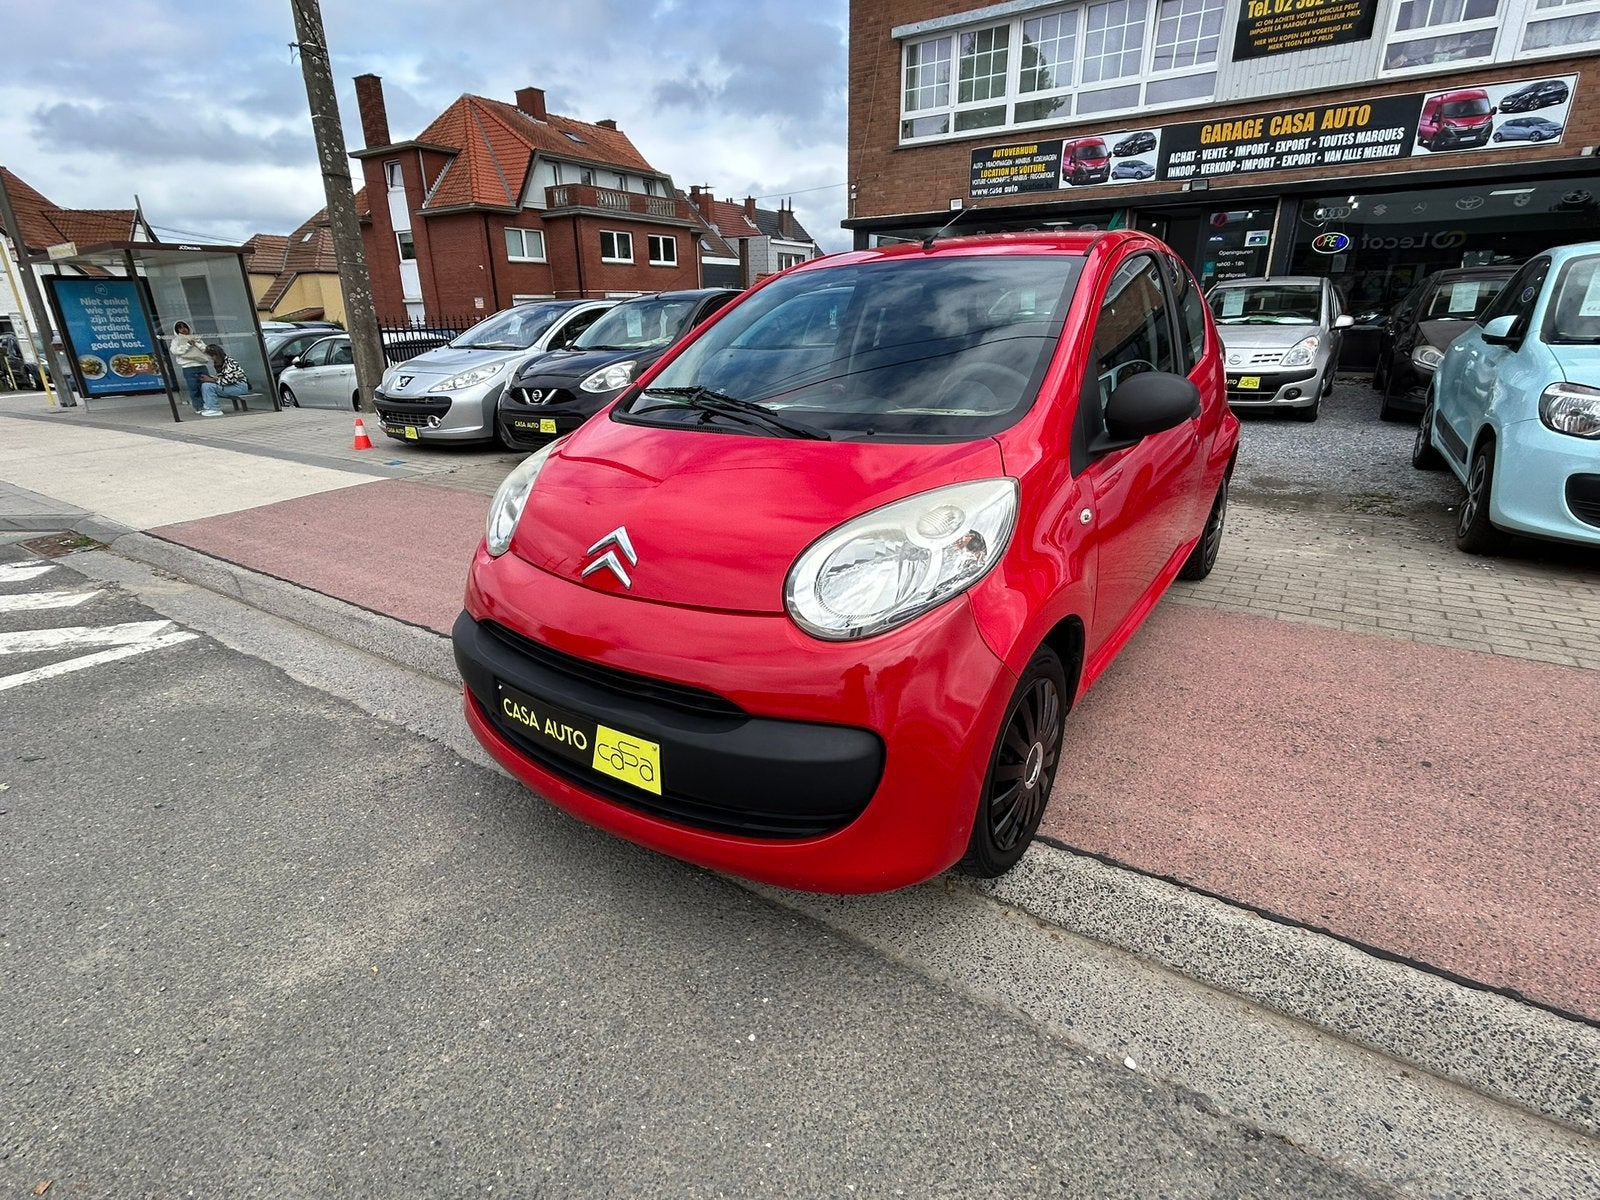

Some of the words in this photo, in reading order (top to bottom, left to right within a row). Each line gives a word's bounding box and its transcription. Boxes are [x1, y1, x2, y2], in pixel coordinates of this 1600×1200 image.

[1248, 1, 1271, 18] Tel.
[1274, 14, 1295, 23] ACHETE
[1297, 10, 1315, 19] VOTRE
[1316, 5, 1343, 15] VEHICULE
[1344, 2, 1360, 10] PEUT
[1282, 20, 1307, 30] MARQUE
[1318, 12, 1346, 22] MEILLEUR
[1346, 10, 1361, 18] PRIX
[1254, 38, 1266, 46] HIER
[1279, 33, 1299, 42] KOPEN
[1268, 42, 1284, 50] MERK
[1284, 39, 1302, 48] TEGEN
[1201, 118, 1263, 144] GARAGE
[1269, 110, 1315, 135] CASA
[1321, 104, 1372, 130] AUTO
[992, 145, 1038, 158] AUTOVERHUUR
[1170, 151, 1197, 164] ACHAT
[1202, 147, 1228, 160] VENTE
[1234, 143, 1270, 158] IMPORT
[1276, 138, 1311, 153] EXPORT
[1319, 132, 1354, 148] TOUTES
[1355, 126, 1405, 144] MARQUES
[1168, 164, 1196, 178] INKOOP
[1200, 161, 1236, 175] VERKOOP
[1241, 157, 1277, 171] IMPORT
[1282, 152, 1317, 168] EXPORT
[1324, 149, 1343, 163] VAN
[1342, 146, 1362, 161] ALLE
[1363, 144, 1401, 159] MERKEN
[980, 167, 1010, 178] LOCATION
[1010, 166, 1018, 175] DE
[1019, 164, 1046, 174] VOITURE
[80, 297, 102, 306] Niet
[104, 297, 129, 306] enkel
[86, 306, 104, 314] wie
[106, 306, 130, 316] goed
[90, 315, 108, 324] zijn
[92, 324, 134, 332] verdient,
[96, 332, 135, 340] verdient
[91, 341, 120, 350] goede
[503, 698, 540, 731] CASA
[544, 718, 588, 750] AUTO
